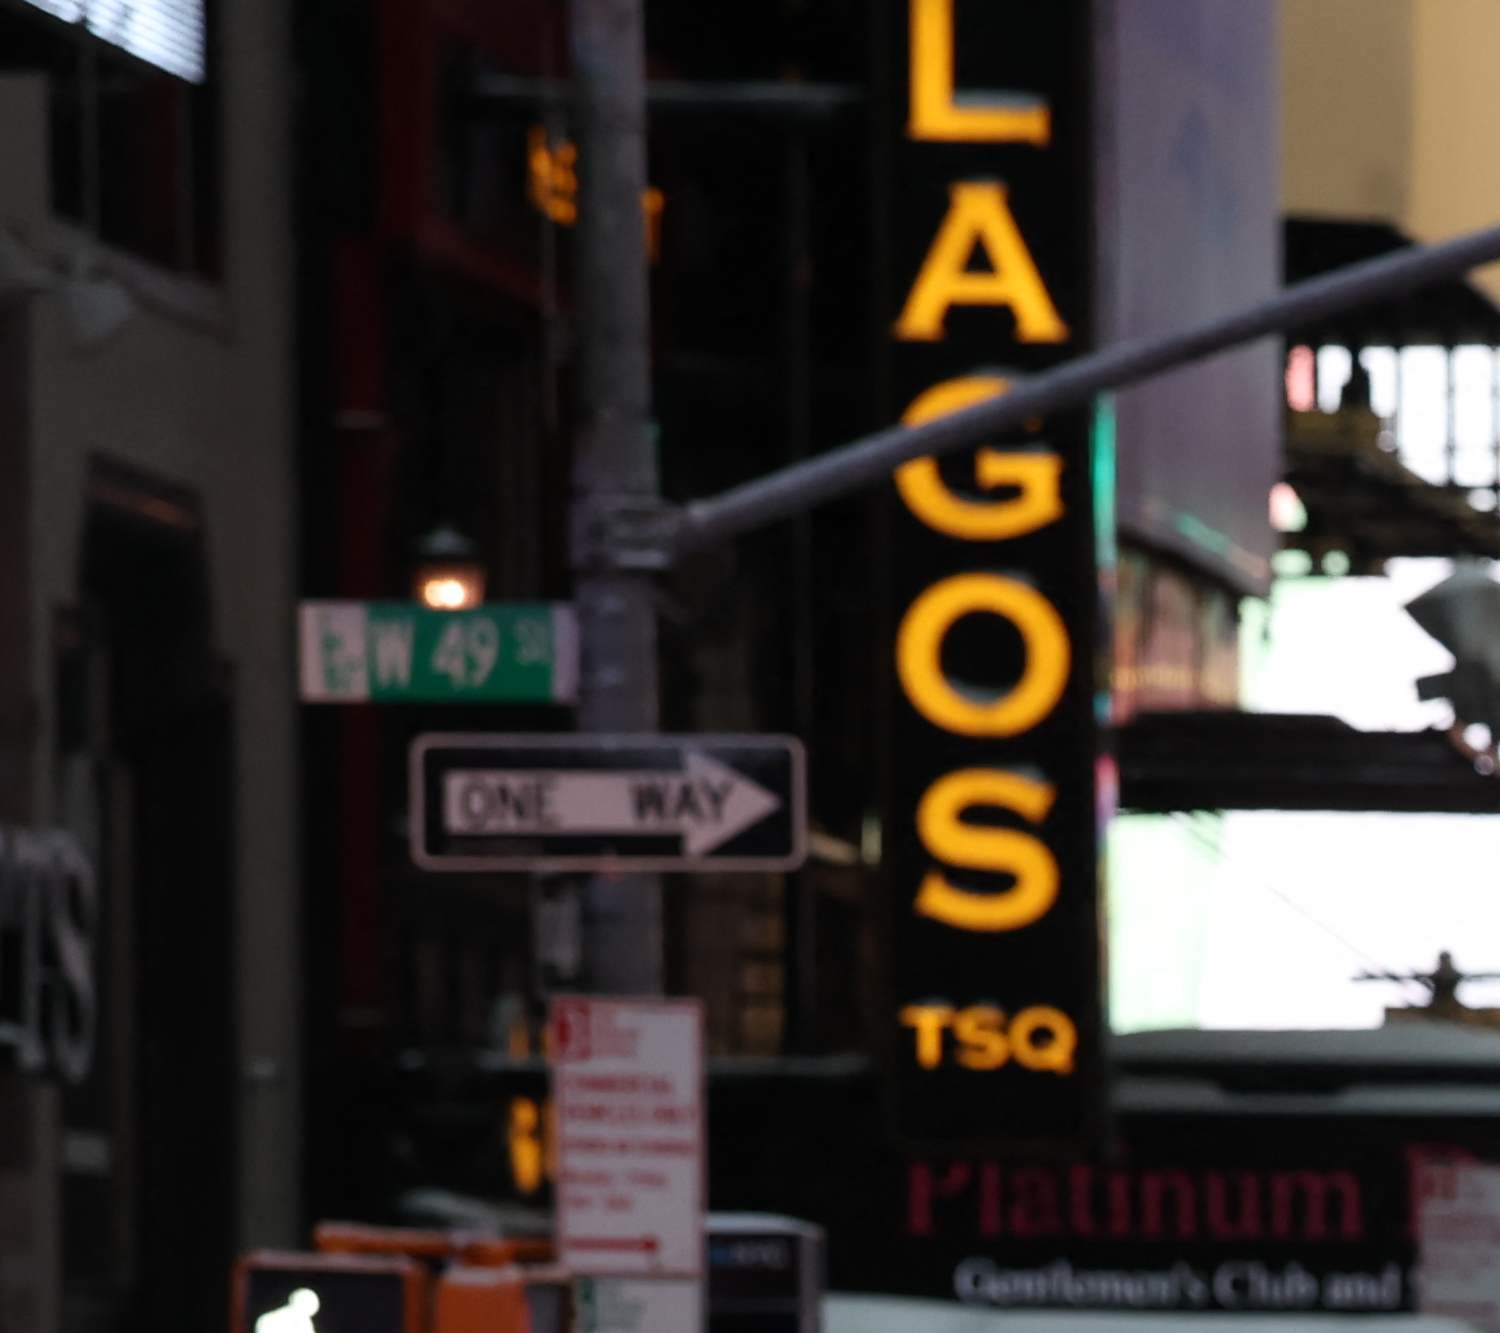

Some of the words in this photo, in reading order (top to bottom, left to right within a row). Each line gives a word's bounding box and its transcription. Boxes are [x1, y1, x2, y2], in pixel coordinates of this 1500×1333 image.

[896, 0, 1070, 931] LAGOS
[373, 618, 415, 688] W
[431, 615, 500, 688] 49
[459, 774, 560, 829] ONE
[628, 778, 736, 823] WAY
[901, 1006, 1075, 1073] TSQ
[907, 1160, 1364, 1240] Platinum
[953, 1256, 1207, 1306] Gentlemen's
[1213, 1262, 1318, 1306] Club
[1323, 1265, 1402, 1306] and
